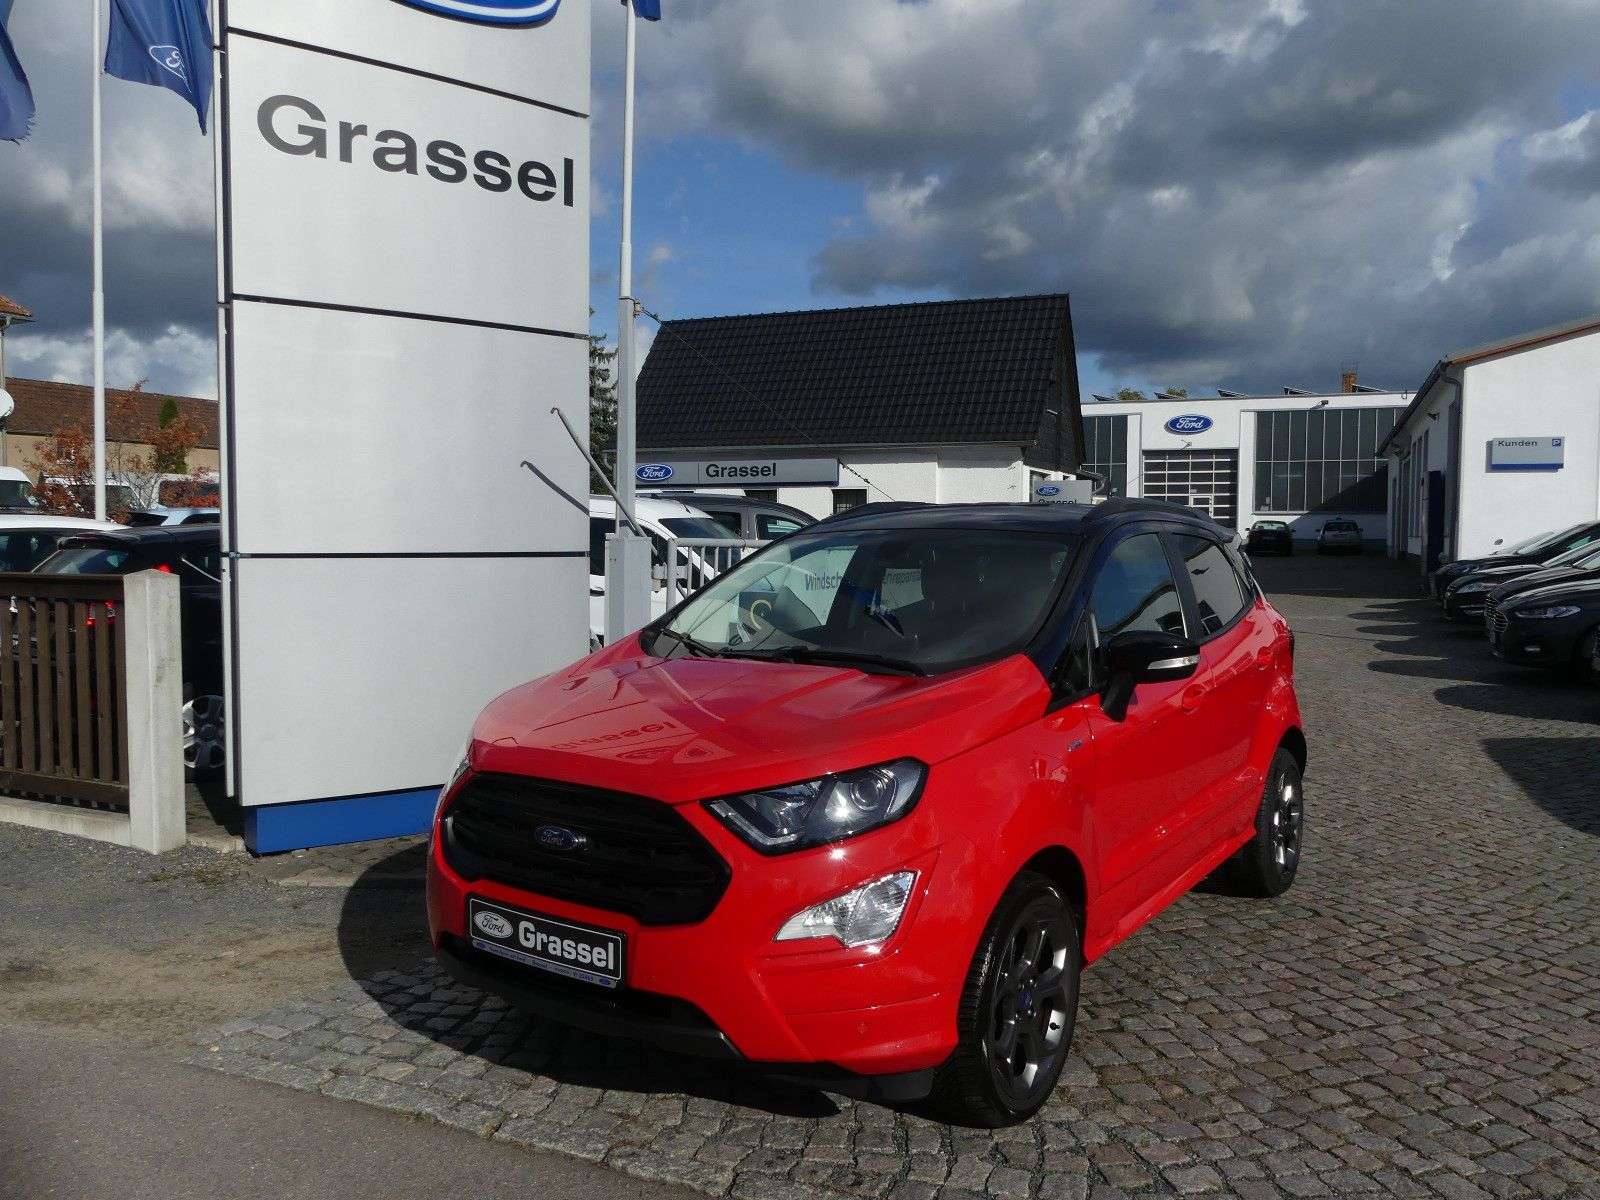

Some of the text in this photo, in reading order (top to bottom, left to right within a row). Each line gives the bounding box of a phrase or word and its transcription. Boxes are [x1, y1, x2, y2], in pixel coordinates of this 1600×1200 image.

[256, 94, 575, 207] Grassel
[1176, 417, 1204, 430] Ford
[643, 462, 777, 479] Ford Grassel
[804, 571, 842, 592] Windsch
[481, 914, 504, 934] Ford
[518, 920, 614, 970] Grassel
